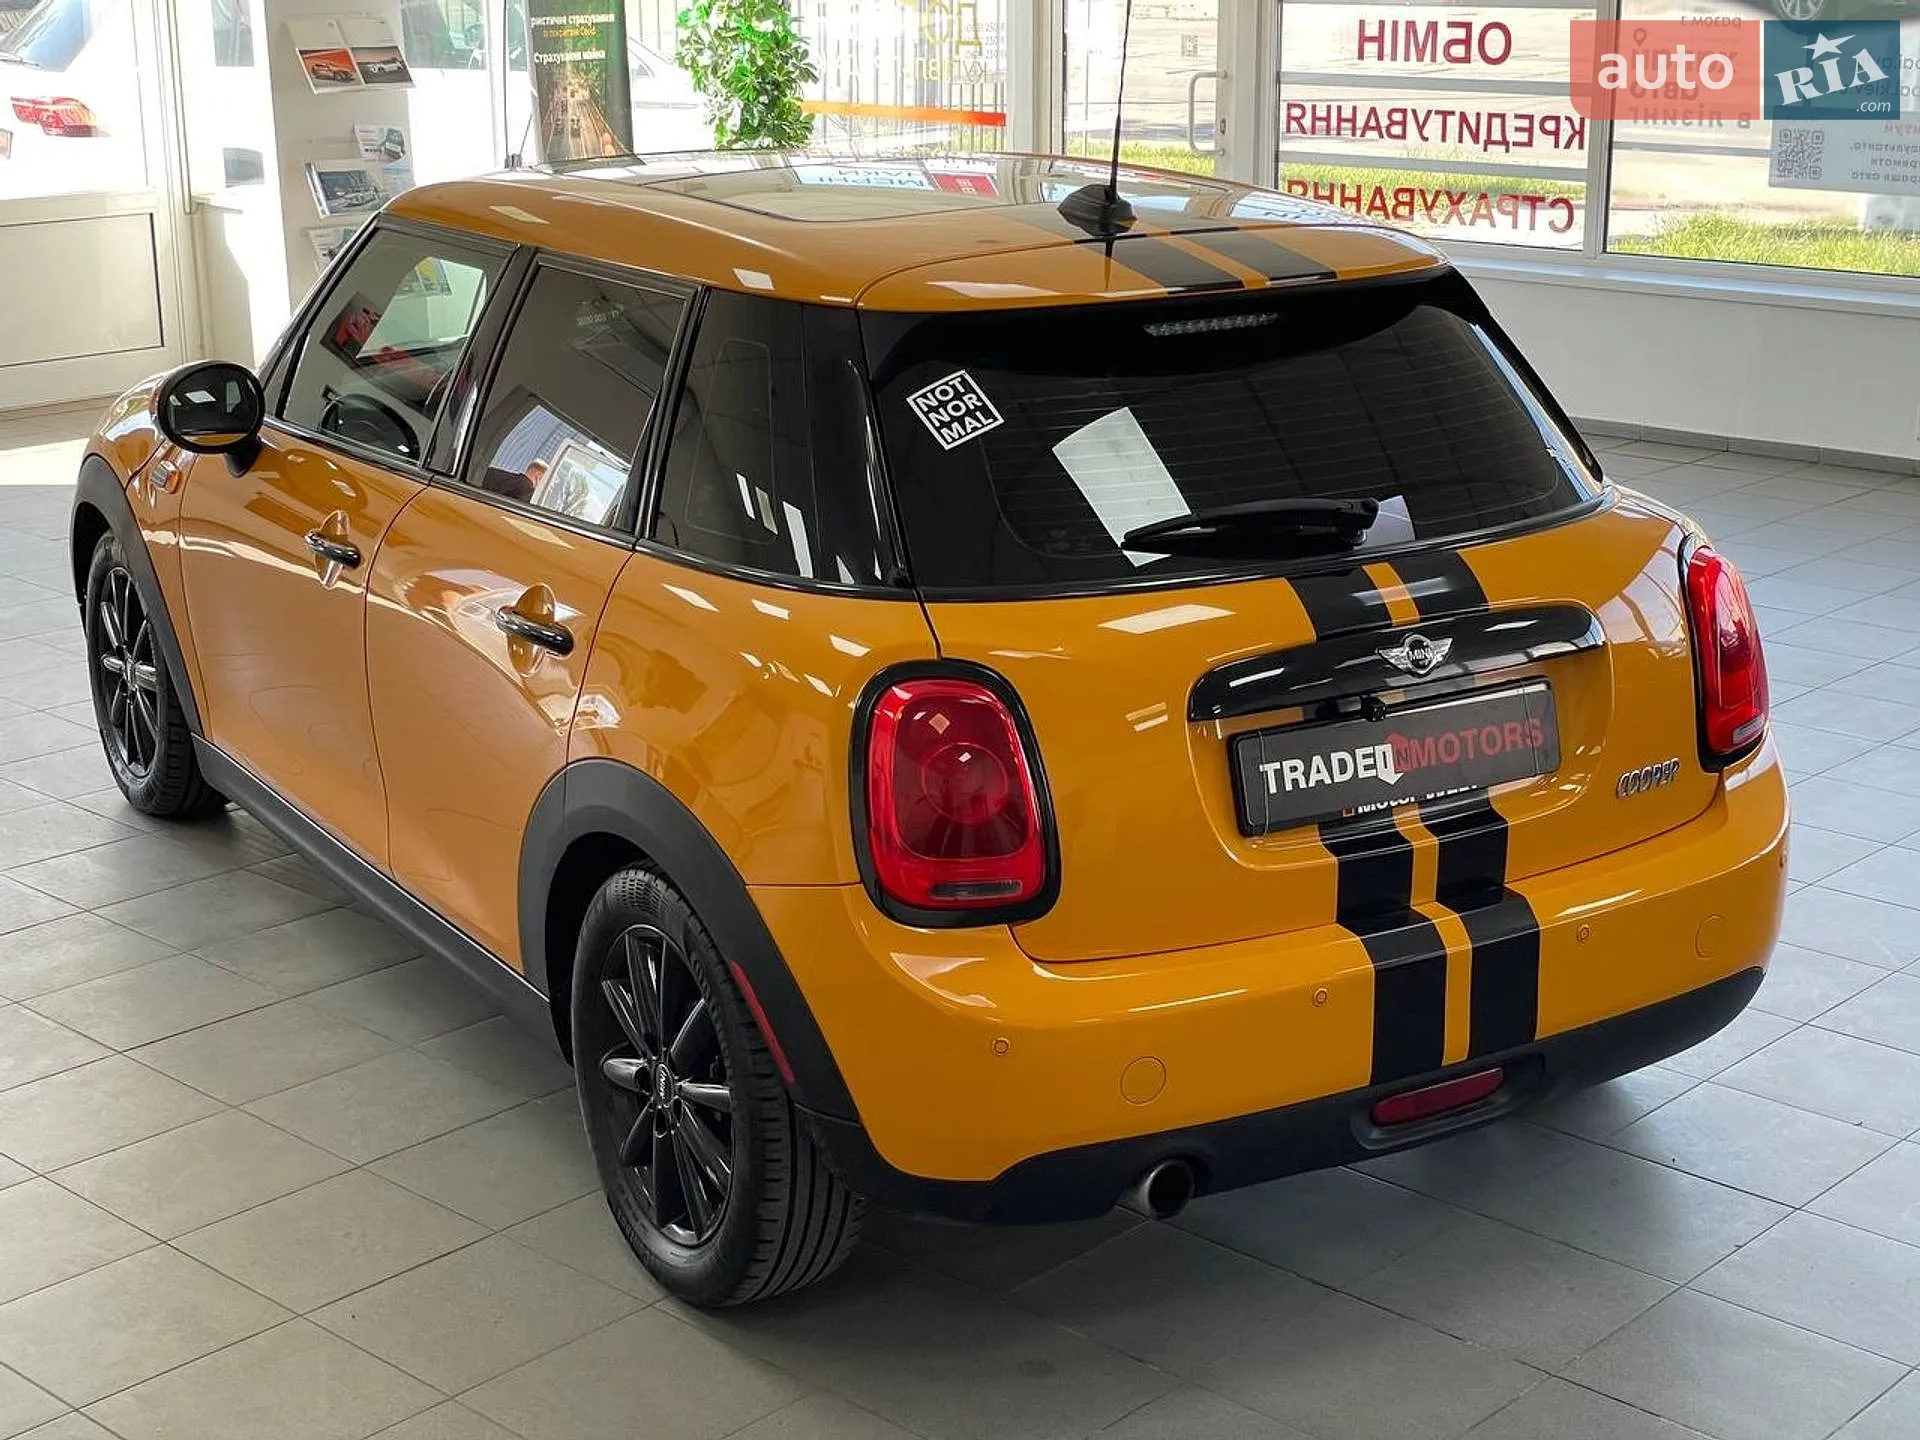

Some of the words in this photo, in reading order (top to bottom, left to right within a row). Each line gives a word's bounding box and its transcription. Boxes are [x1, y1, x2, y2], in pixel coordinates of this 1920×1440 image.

[916, 377, 965, 411] NOT
[929, 393, 982, 427] NOR
[941, 411, 994, 443] MAL
[1616, 757, 1681, 799] COOPER
